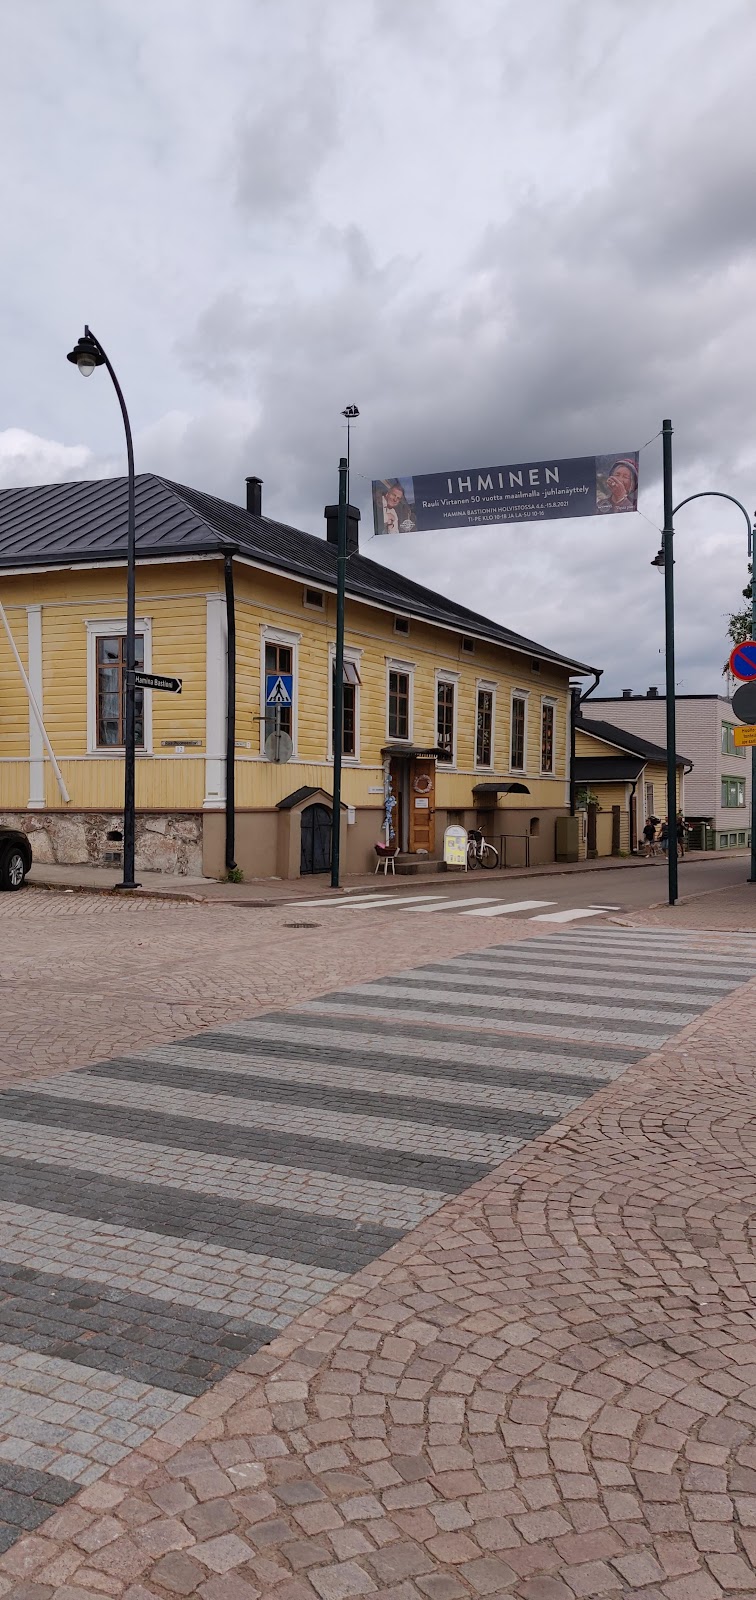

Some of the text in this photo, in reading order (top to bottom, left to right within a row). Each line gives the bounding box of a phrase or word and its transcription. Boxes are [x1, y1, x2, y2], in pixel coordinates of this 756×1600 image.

[447, 467, 560, 494] IHMINEN
[422, 500, 440, 508] Rauli
[471, 495, 480, 503] 50
[504, 490, 540, 499] maailmalla
[542, 485, 590, 498] -juhlanäyttely
[467, 507, 497, 516] BASTIONIN
[497, 504, 535, 512] HOLVISTOSSA
[135, 675, 174, 689] Hamina Bastioni
